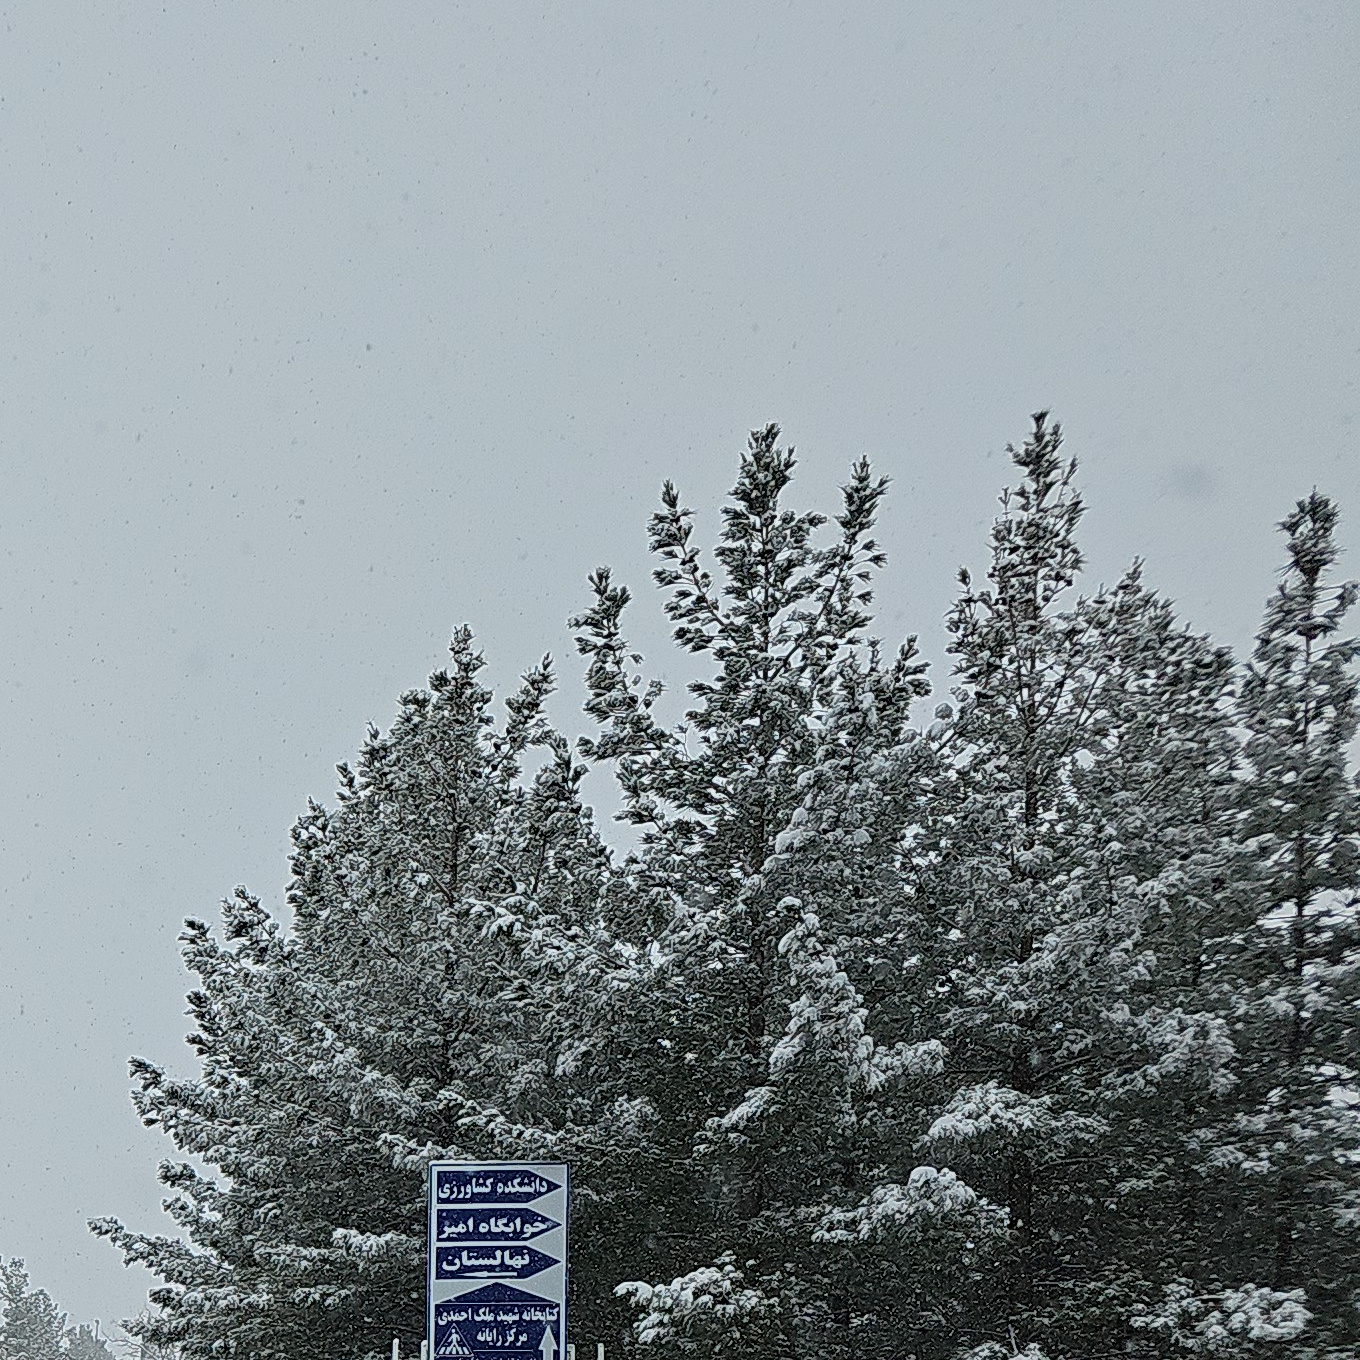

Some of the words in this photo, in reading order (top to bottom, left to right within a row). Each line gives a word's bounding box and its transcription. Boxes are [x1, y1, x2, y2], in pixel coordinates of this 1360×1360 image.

[438, 1177, 494, 1200] کشاورزی
[496, 1176, 548, 1194] دانشکده
[438, 1216, 474, 1239] امیر
[478, 1216, 548, 1240] خوابگاه
[441, 1249, 530, 1272] نهالستان
[437, 1307, 472, 1326] احمدی
[473, 1306, 495, 1322] ملک
[496, 1306, 520, 1324] شهید
[521, 1306, 559, 1325] کتابخانه
[476, 1327, 503, 1347] رایانه
[503, 1328, 528, 1347] مرکز
